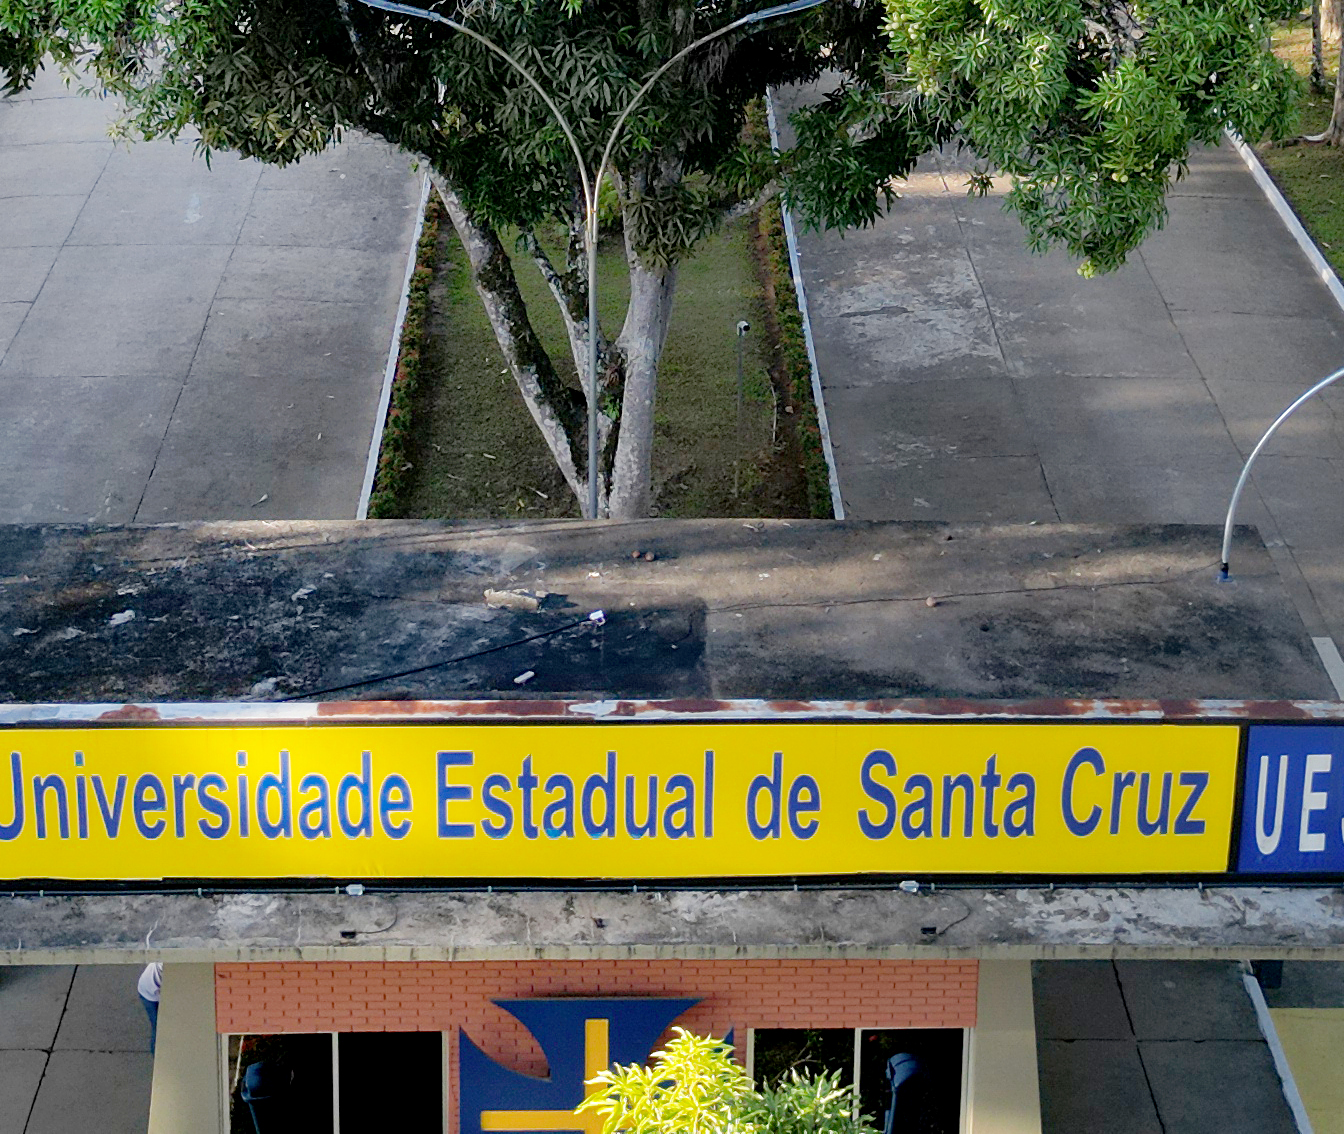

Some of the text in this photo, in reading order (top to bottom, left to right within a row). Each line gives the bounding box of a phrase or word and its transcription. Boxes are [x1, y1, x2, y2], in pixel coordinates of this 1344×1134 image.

[437, 751, 714, 840] Estadual
[747, 752, 822, 840] de
[858, 749, 1036, 840] Santa
[1061, 747, 1209, 838] Cruz
